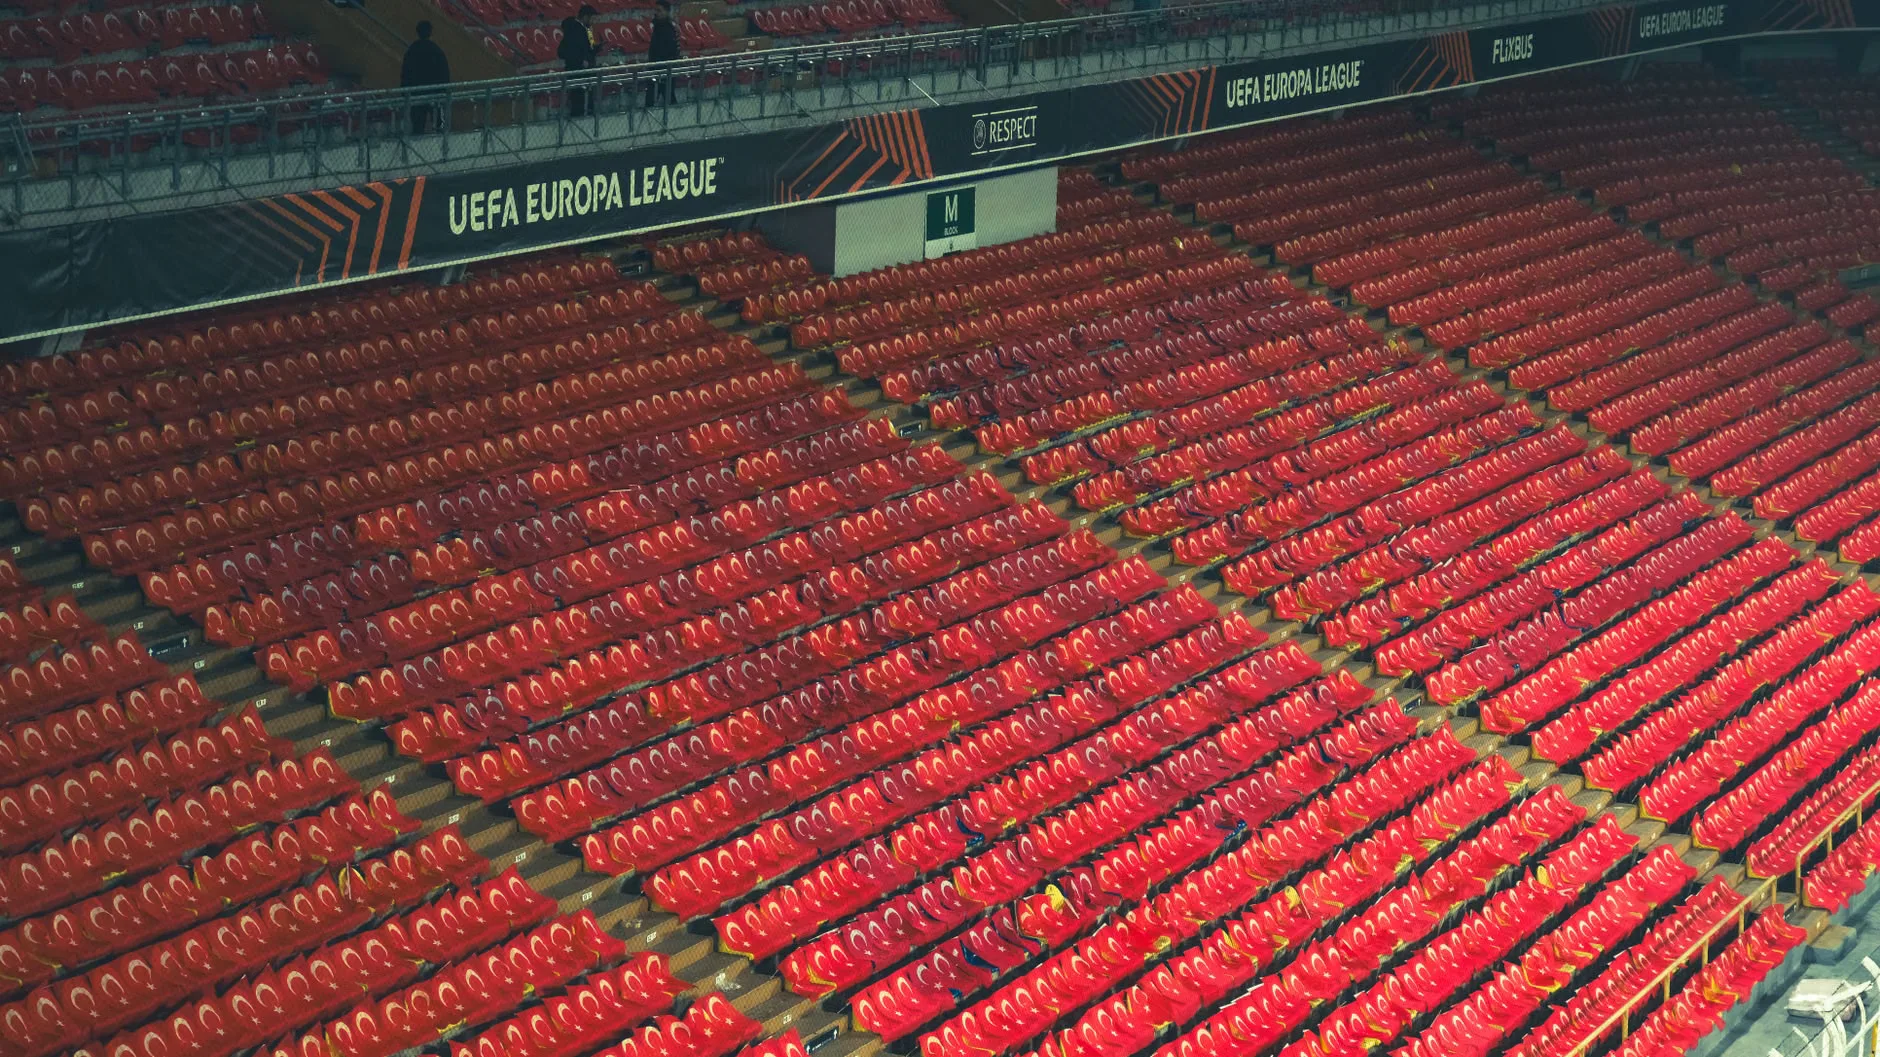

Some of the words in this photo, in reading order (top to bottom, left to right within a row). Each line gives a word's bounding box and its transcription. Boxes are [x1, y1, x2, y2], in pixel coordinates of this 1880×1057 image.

[1640, 14, 1660, 38] UEFA
[1661, 10, 1691, 35] EUROPA
[1692, 4, 1724, 29] LEAGUE
[1227, 77, 1260, 108] UEFA
[1264, 68, 1312, 101] EUROPA
[1315, 60, 1360, 93] LEAGUE
[990, 115, 1037, 143] RESPECT
[449, 187, 520, 236] UEFA
[526, 171, 623, 224] EUROPA
[630, 157, 717, 206] LEAGUE
[945, 194, 958, 223] M
